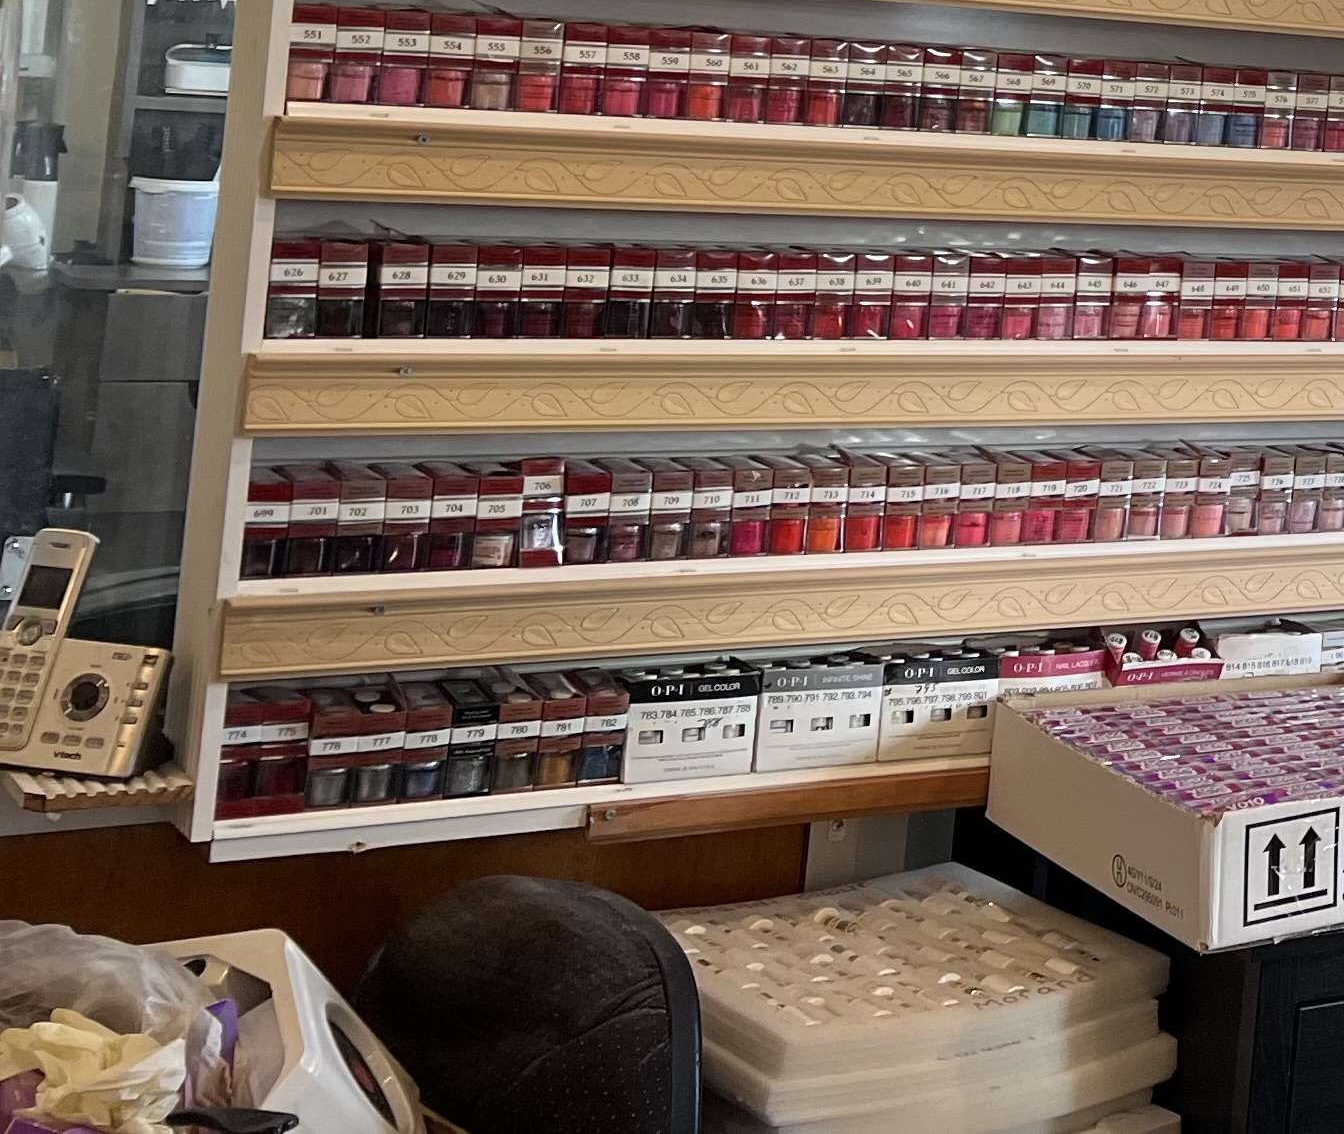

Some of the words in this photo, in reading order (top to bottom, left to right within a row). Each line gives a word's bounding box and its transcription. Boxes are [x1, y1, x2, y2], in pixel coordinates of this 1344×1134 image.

[303, 30, 322, 38] 551
[351, 34, 370, 44] 552
[397, 37, 416, 47] 553
[443, 40, 462, 50] 554
[486, 42, 505, 51] 555
[533, 45, 552, 55] 556
[578, 50, 596, 59] 557
[705, 57, 722, 67] 560
[743, 62, 758, 70] 561
[1041, 78, 1056, 86] 569
[283, 267, 303, 276] 626
[328, 271, 348, 281] 627
[392, 271, 410, 279] 628
[446, 271, 466, 280] 629
[488, 274, 506, 283] 630
[531, 272, 548, 281] 631
[670, 274, 687, 283] 634
[710, 275, 728, 284] 635
[788, 277, 804, 286] 637
[533, 481, 551, 491] 706
[1072, 483, 1088, 492] 720
[703, 494, 720, 504] 710
[822, 490, 838, 499] 713
[579, 498, 597, 507] 707
[662, 496, 679, 505] 709
[308, 506, 327, 515] 701
[348, 507, 367, 517] 702
[400, 505, 419, 514] 703
[444, 504, 463, 513] 704
[487, 504, 506, 513] 705
[555, 722, 573, 732] 781
[600, 718, 617, 728] 782
[227, 729, 246, 739] 774
[277, 727, 296, 738] 775
[467, 728, 486, 739] 779
[510, 725, 529, 735] 780
[372, 737, 391, 748] 777
